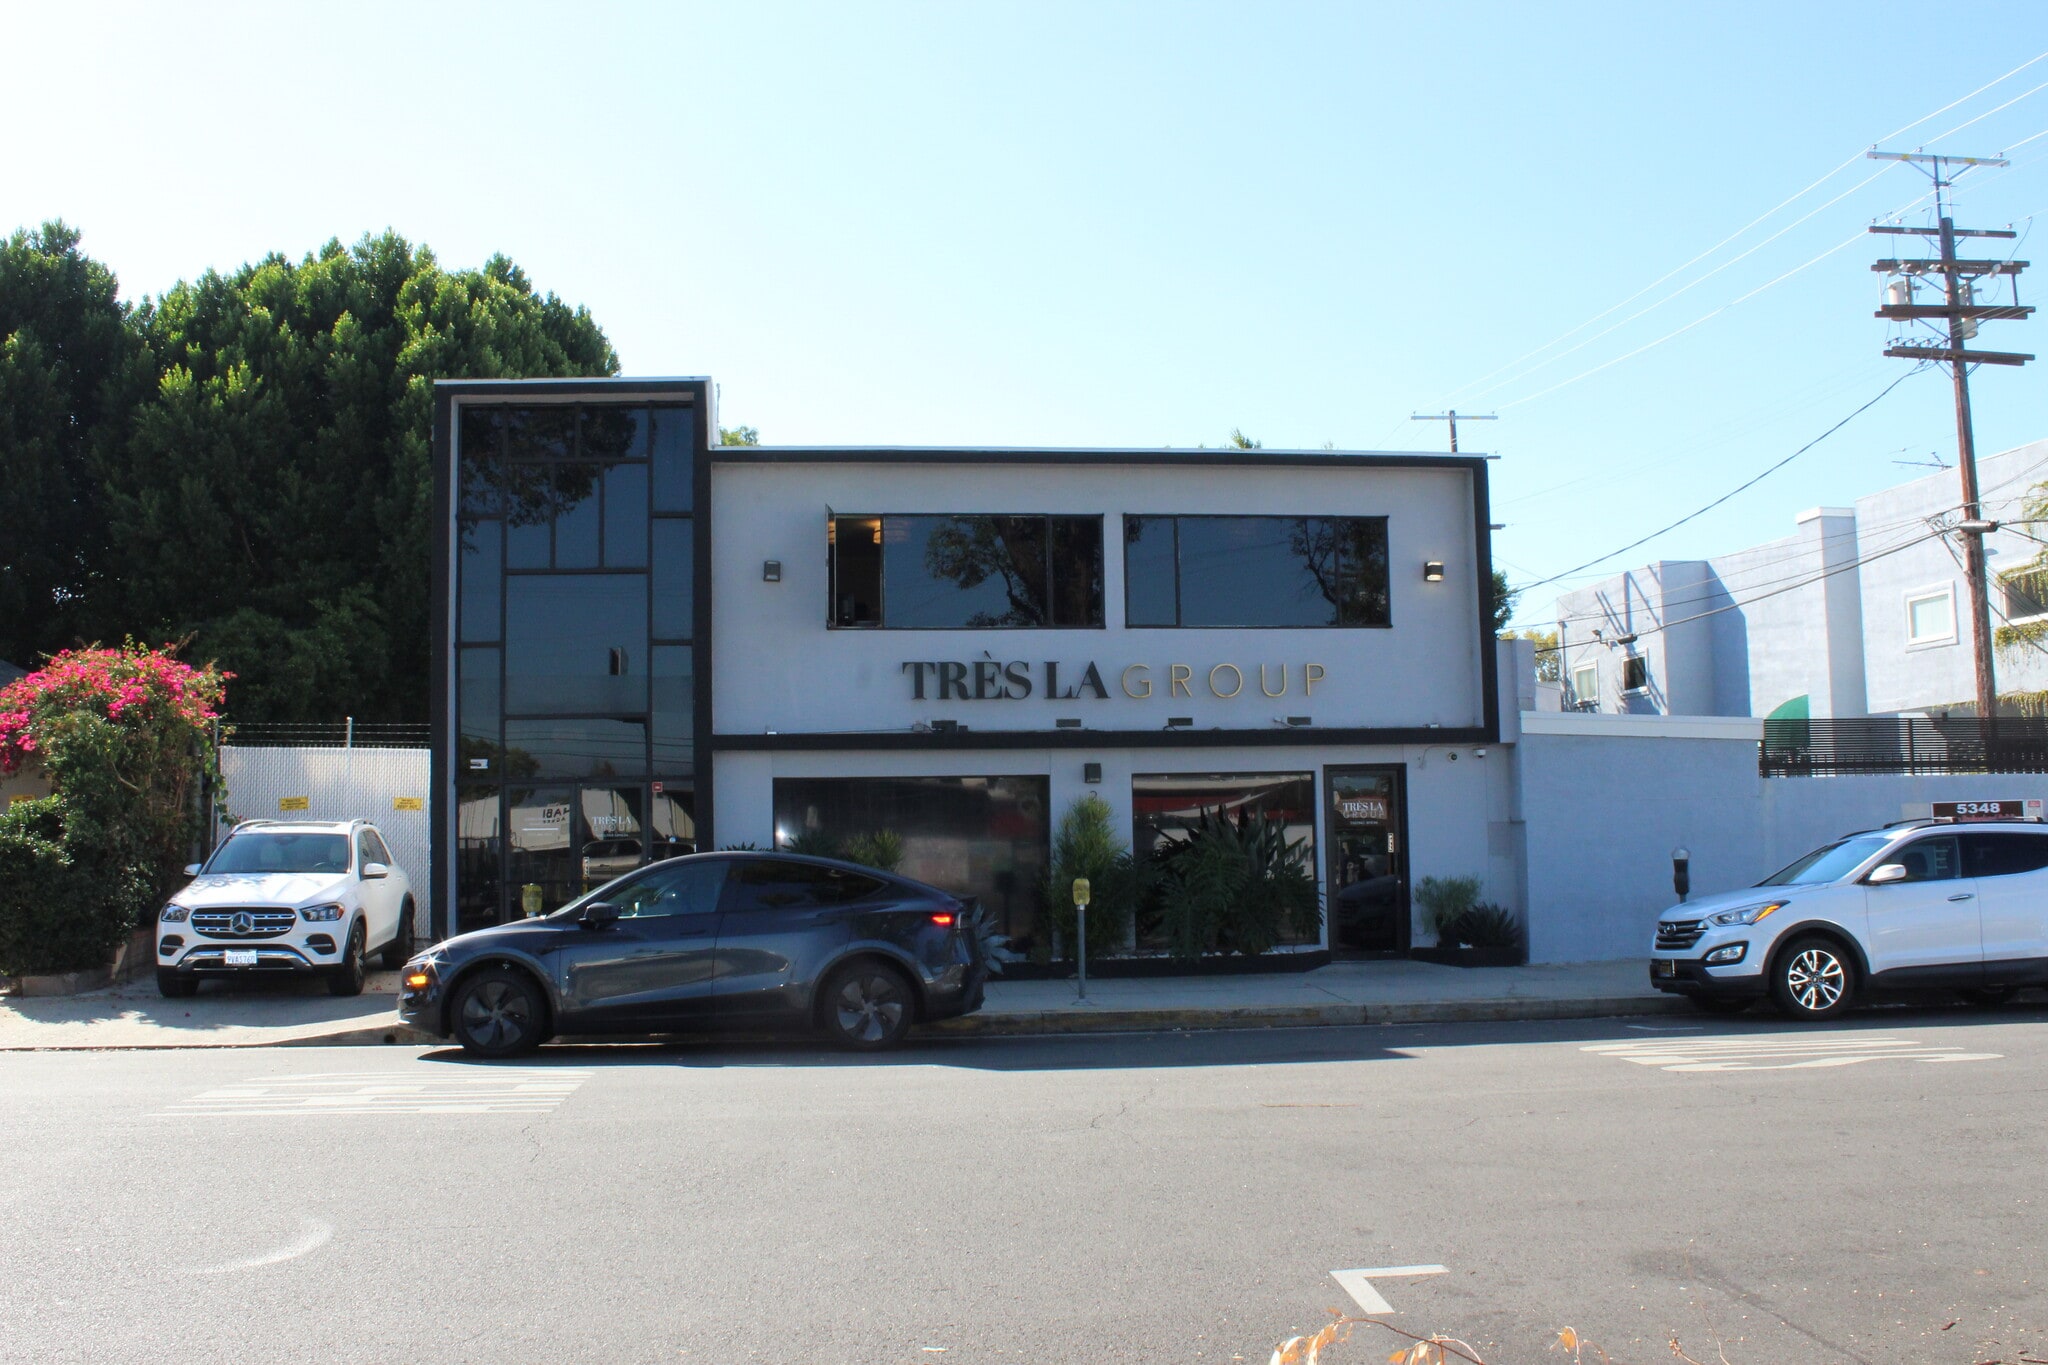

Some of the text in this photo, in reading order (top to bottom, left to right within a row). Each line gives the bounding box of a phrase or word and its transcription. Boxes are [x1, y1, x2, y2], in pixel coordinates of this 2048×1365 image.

[902, 650, 1327, 700] TRÈS LA GROUP
[1370, 802, 1383, 811] LA
[1956, 803, 2000, 814] 5348
[1343, 811, 1384, 819] GROUP
